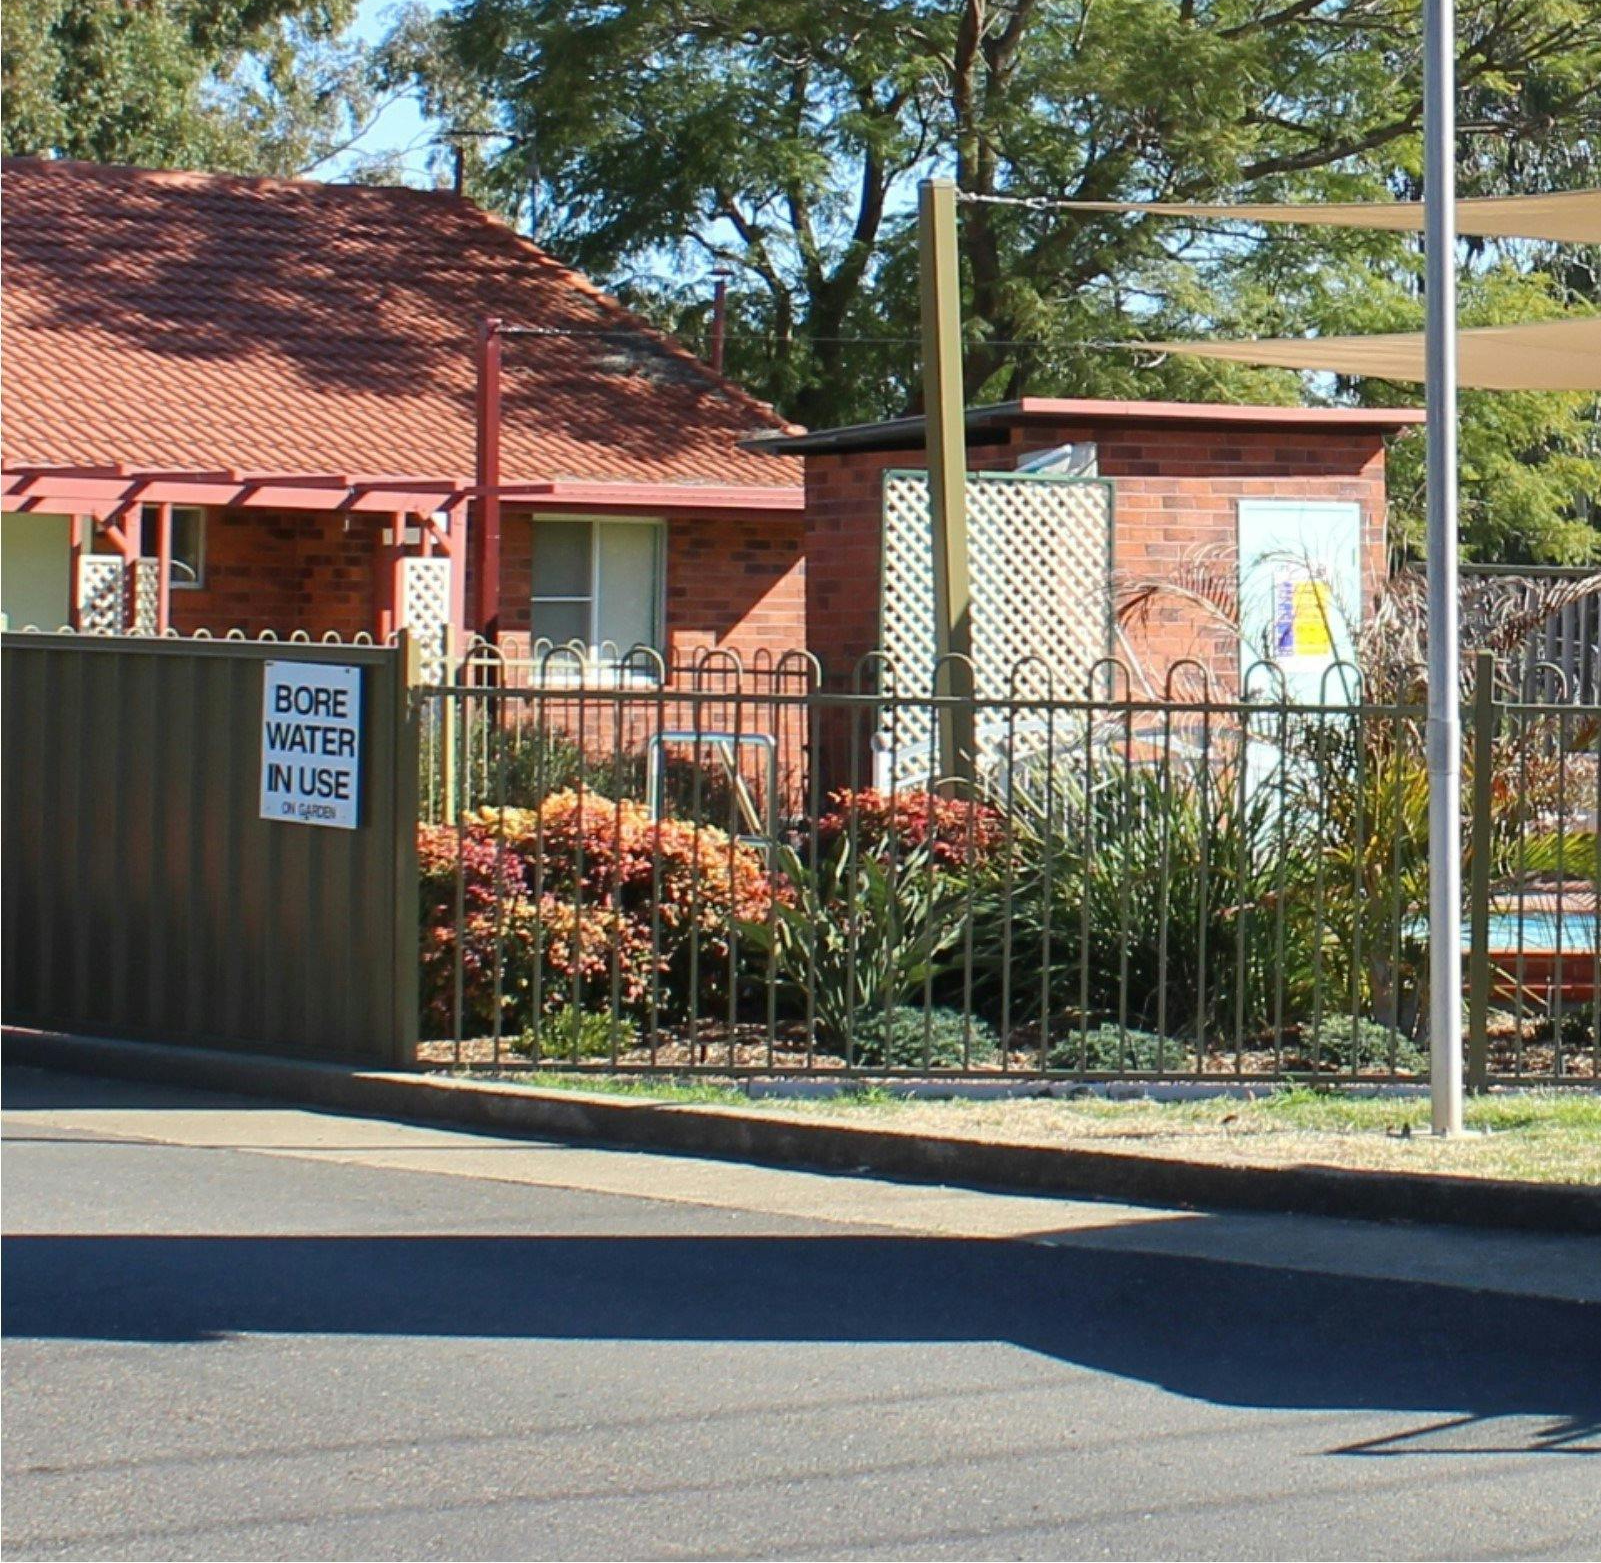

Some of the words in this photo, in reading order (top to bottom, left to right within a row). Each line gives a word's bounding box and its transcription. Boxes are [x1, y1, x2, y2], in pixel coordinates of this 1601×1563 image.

[275, 684, 348, 718] BORE
[266, 721, 355, 757] WATER
[267, 763, 292, 794] IN
[299, 766, 350, 800] USE
[299, 803, 336, 819] GARDEN
